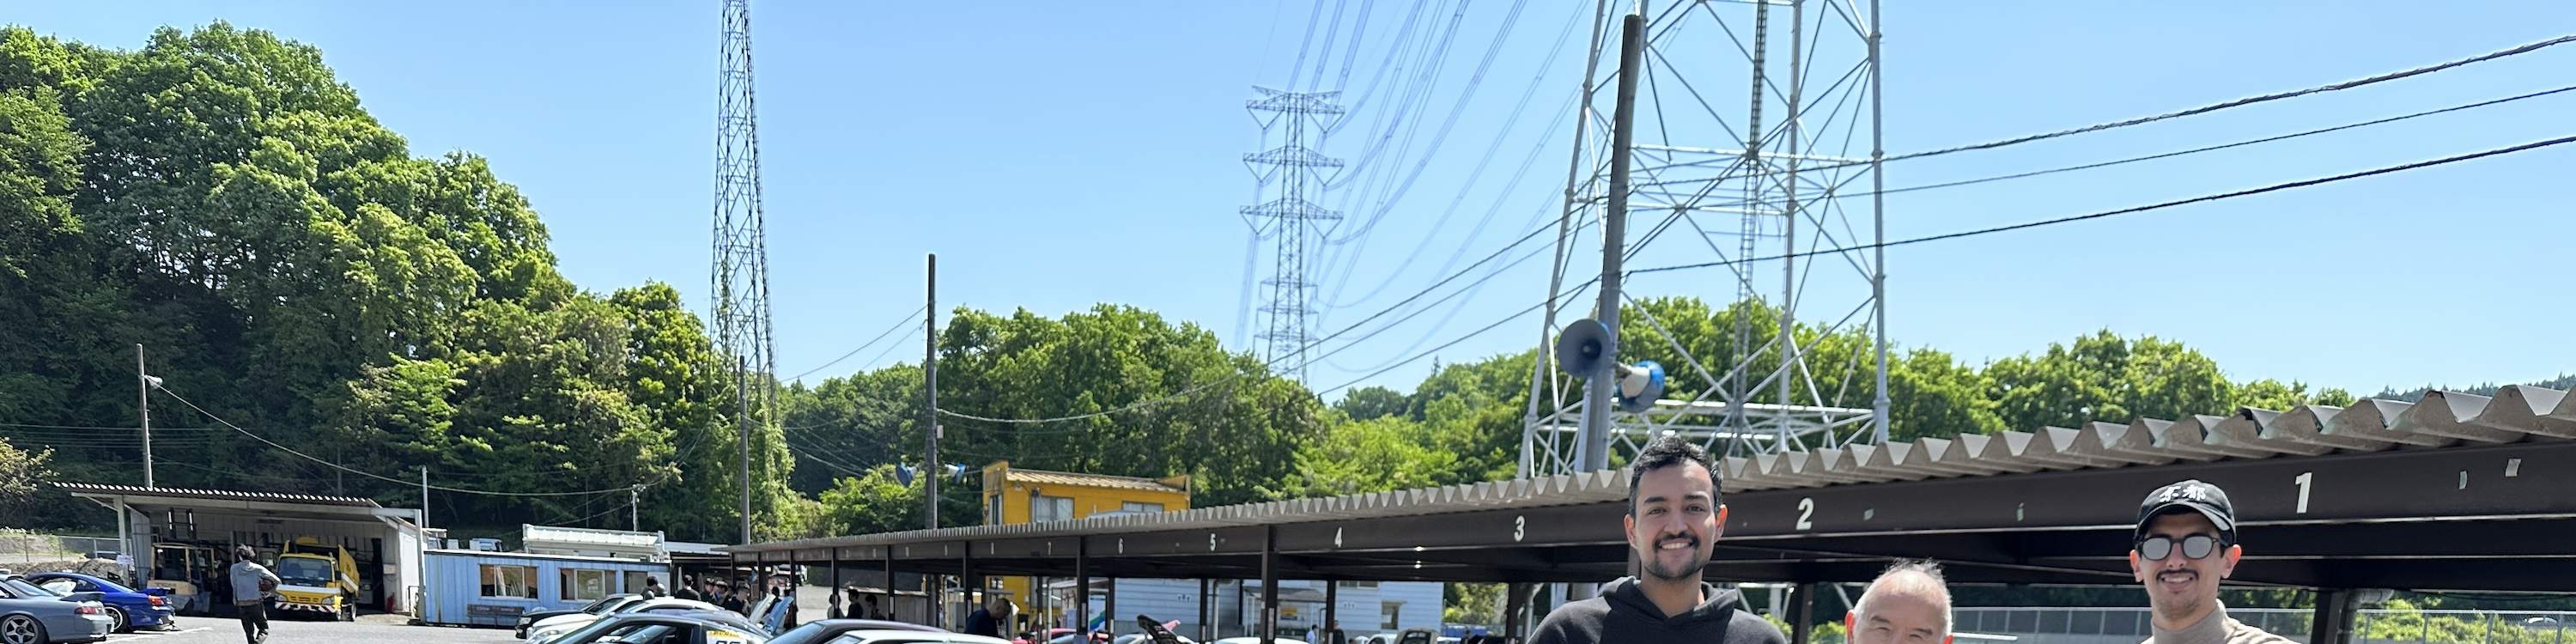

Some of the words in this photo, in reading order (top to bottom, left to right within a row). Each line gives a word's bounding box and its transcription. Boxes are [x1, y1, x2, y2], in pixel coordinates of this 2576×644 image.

[2295, 471, 2312, 513] 1
[1795, 497, 1814, 531] 2
[1334, 526, 1343, 548] 4
[1514, 515, 1525, 542] 3
[1118, 538, 1124, 554] 6
[1210, 532, 1217, 551] 5
